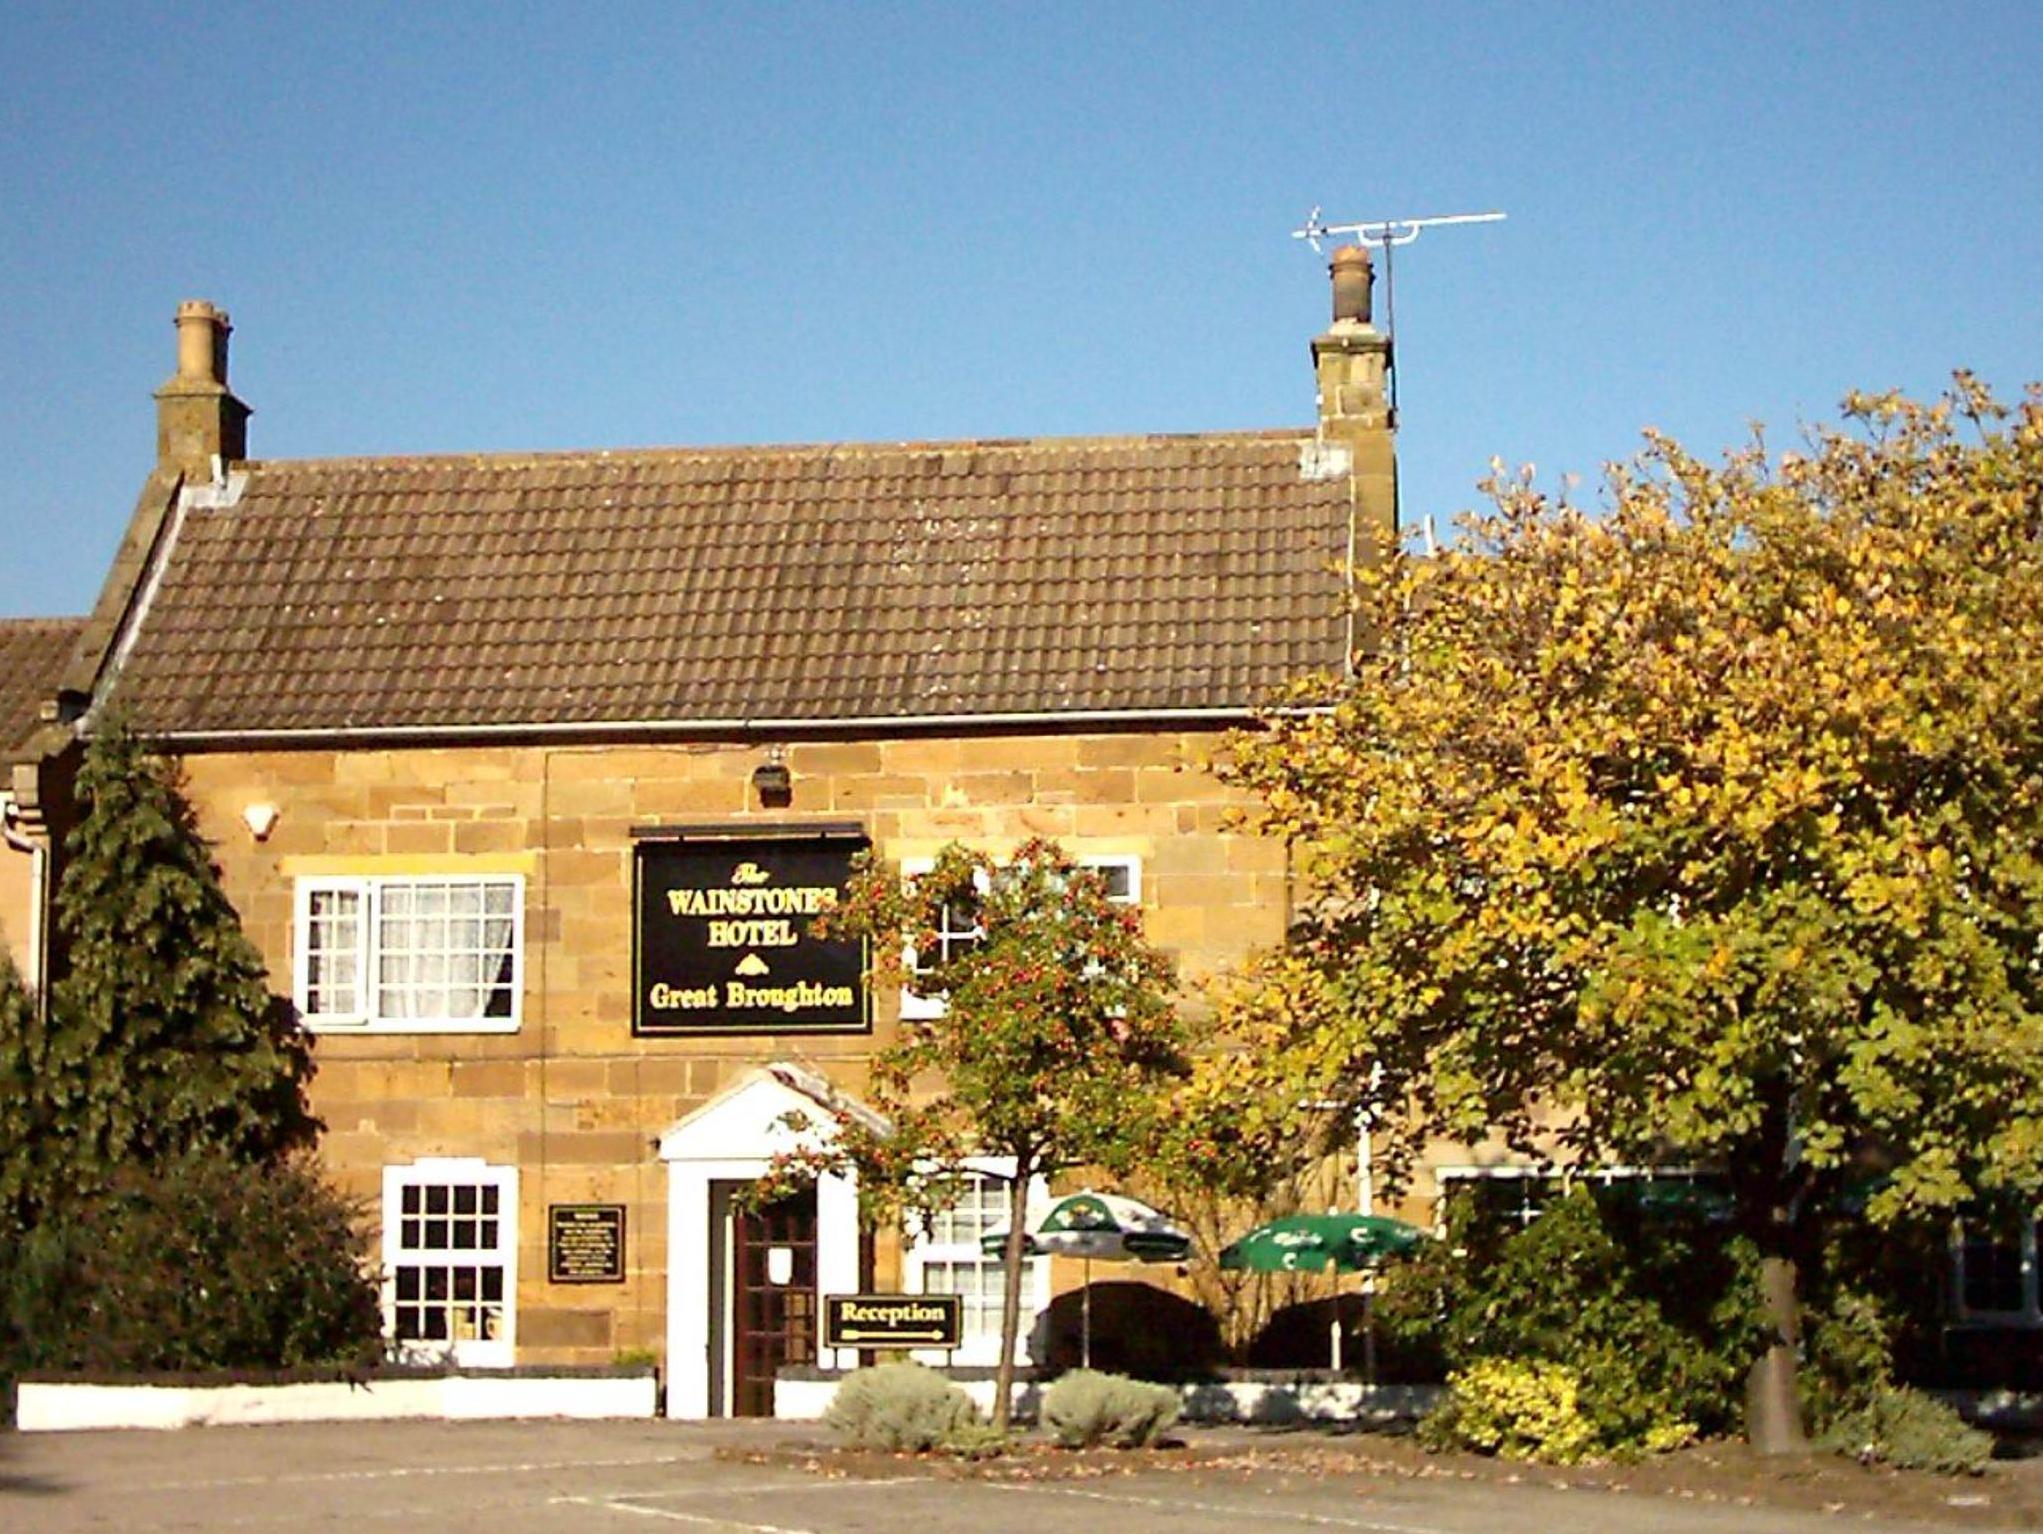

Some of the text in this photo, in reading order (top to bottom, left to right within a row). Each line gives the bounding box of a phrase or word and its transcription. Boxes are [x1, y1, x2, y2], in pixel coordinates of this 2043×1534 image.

[731, 862, 771, 885] The
[707, 920, 798, 947] HOTEL
[650, 980, 854, 1013] Great Broughton
[841, 1301, 946, 1328] Reception
